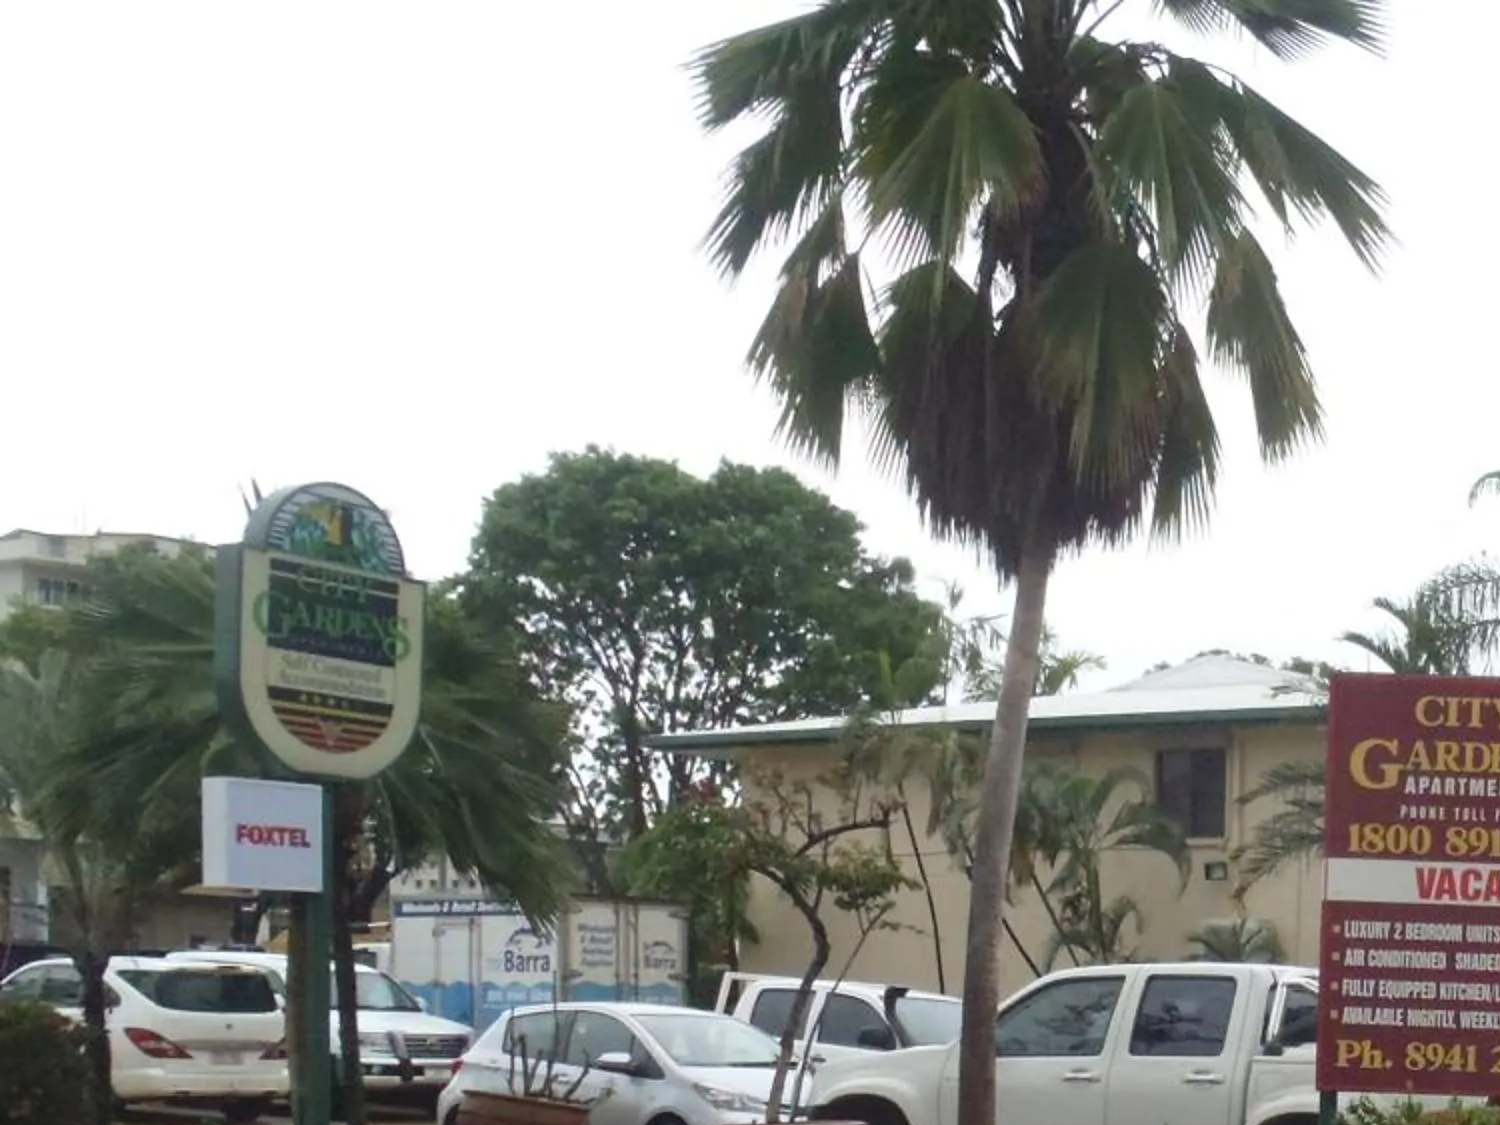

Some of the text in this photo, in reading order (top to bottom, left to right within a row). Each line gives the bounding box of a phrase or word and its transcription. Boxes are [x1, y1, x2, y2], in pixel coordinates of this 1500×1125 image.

[1400, 804, 1446, 821] PHONE
[1454, 807, 1487, 822] TOLL
[236, 824, 311, 848] FOXTEL
[1349, 822, 1432, 855] 1800
[1344, 920, 1390, 939] LUXURY
[1393, 923, 1402, 939] 2
[1405, 924, 1462, 942] BEDROOM
[503, 950, 551, 973] Barra
[1344, 948, 1365, 967] AIR
[1368, 950, 1446, 969] CONDITIONED
[1342, 978, 1374, 997] FULLY
[1378, 980, 1436, 999] EQUIPPED
[1341, 1006, 1404, 1026] AVAILABLE
[1334, 1039, 1393, 1069] Ph.
[1405, 1041, 1478, 1073] 8941
